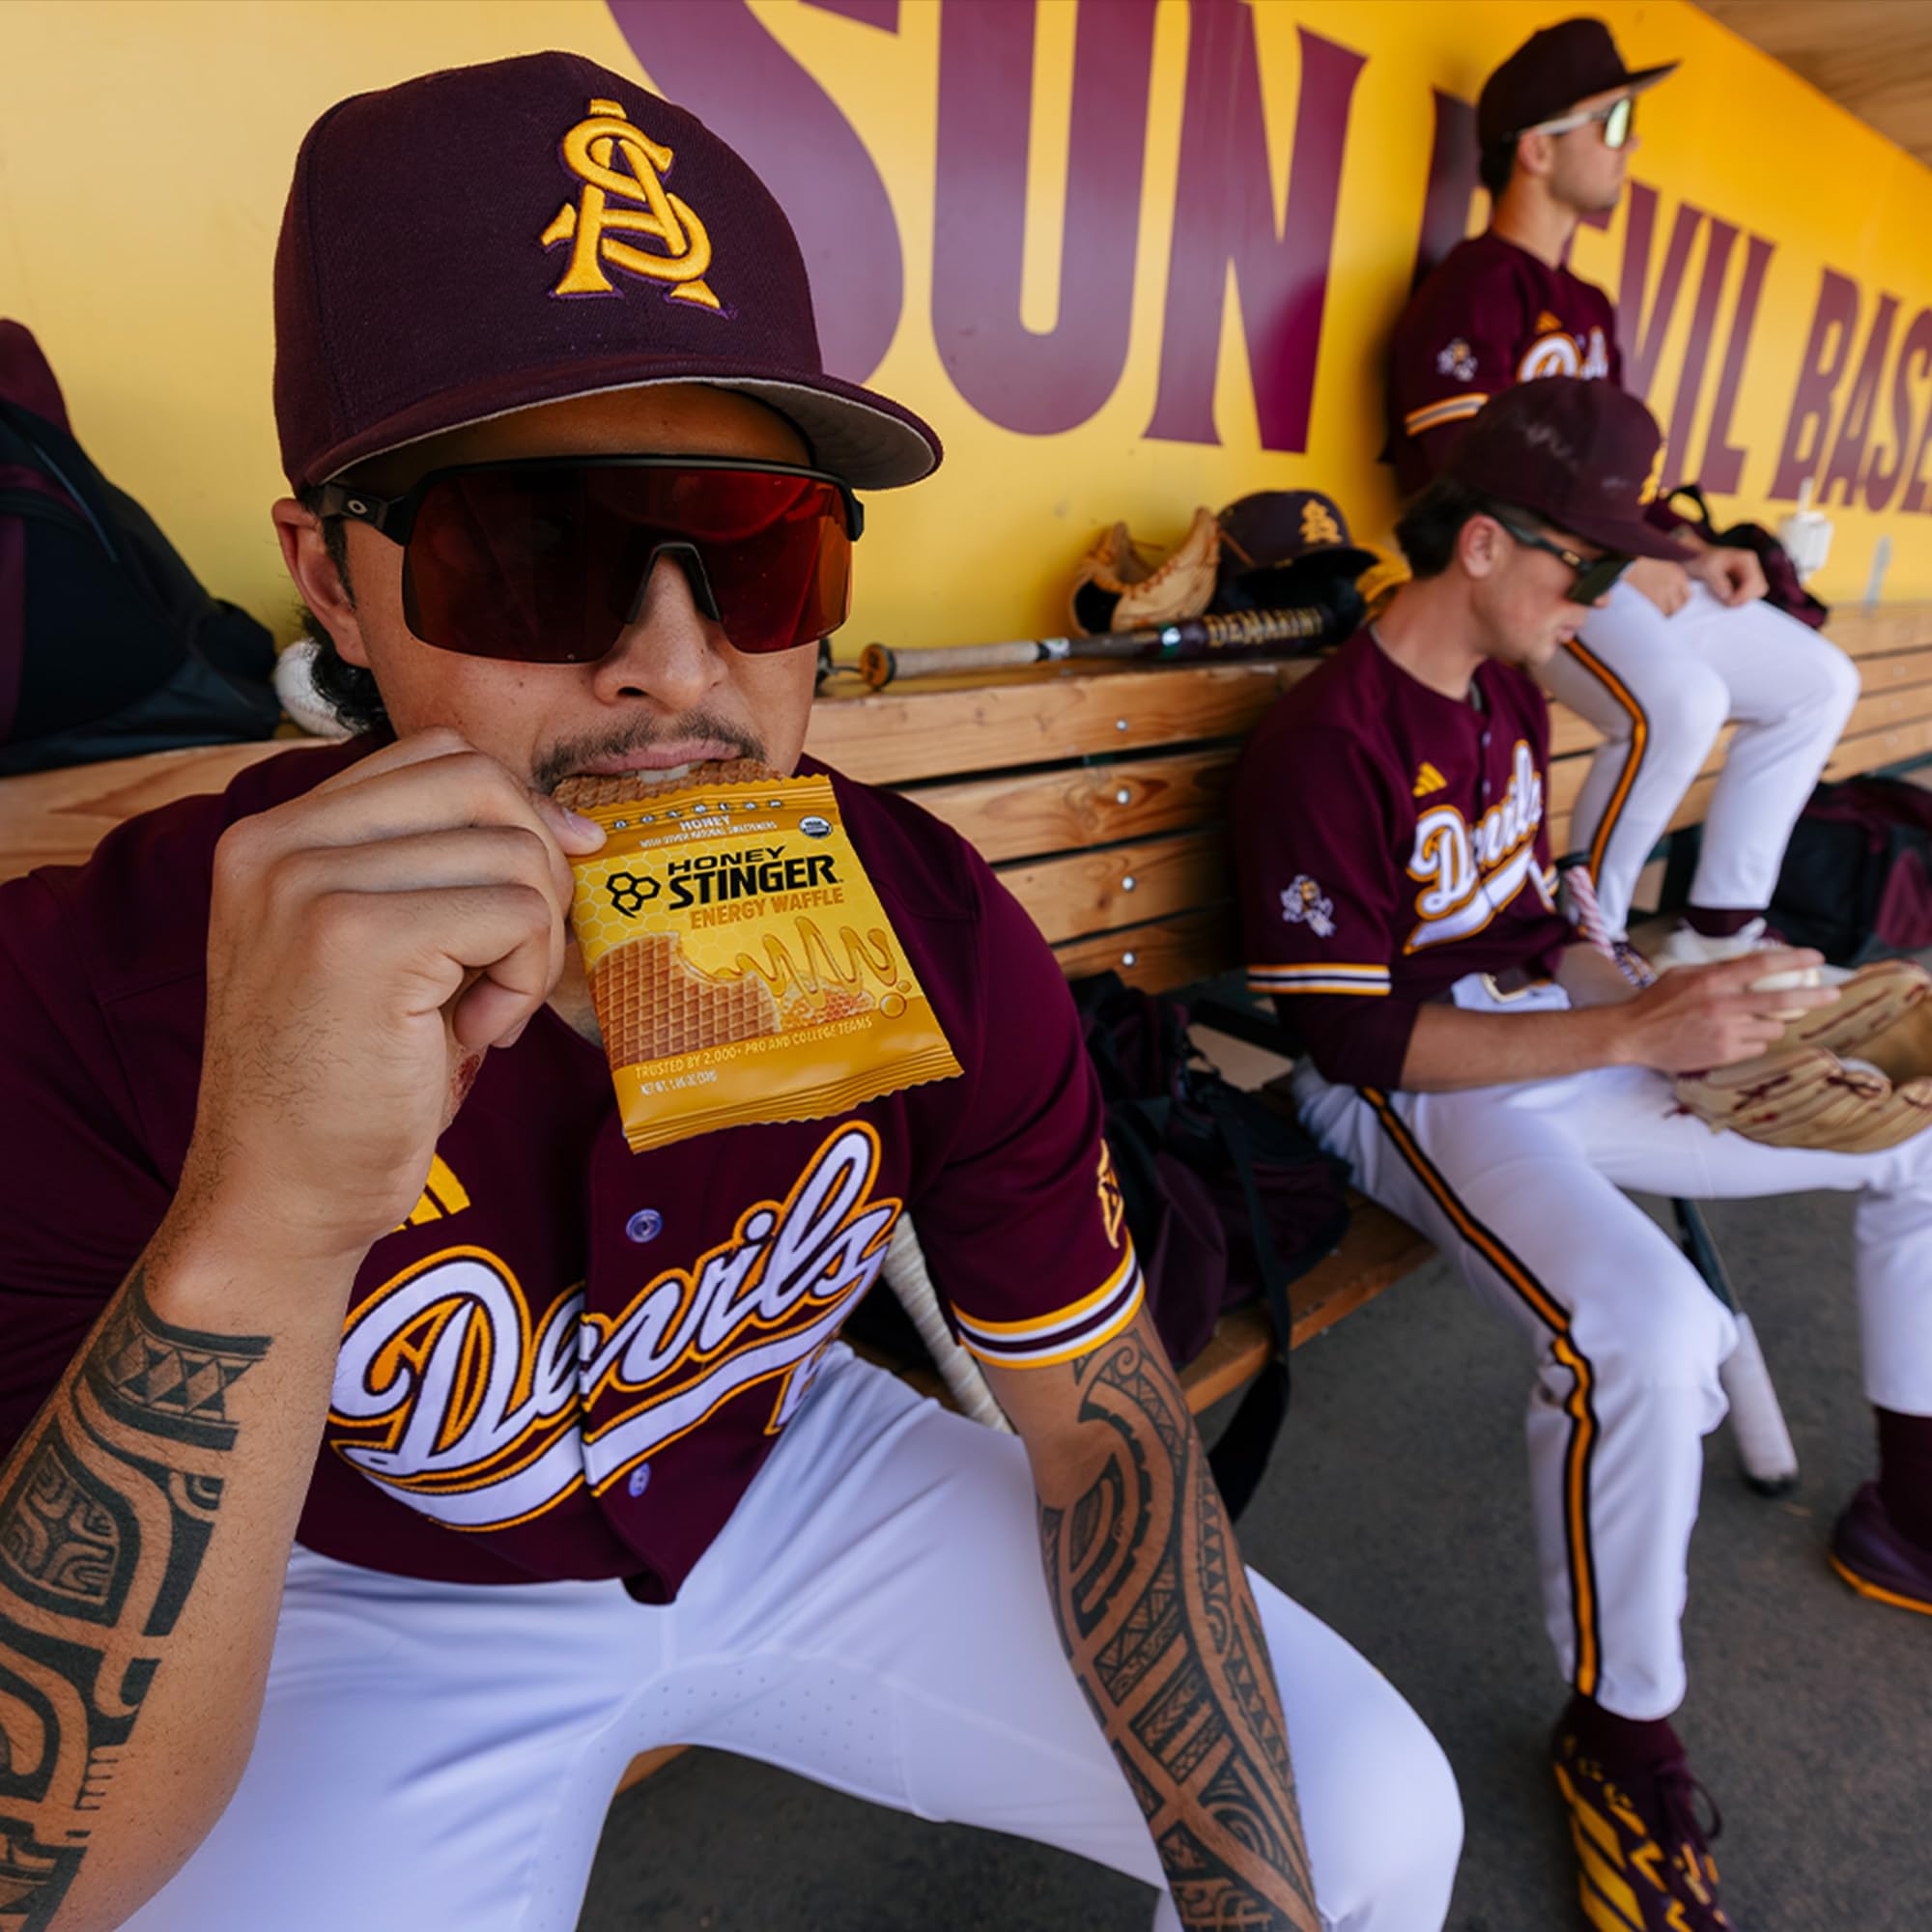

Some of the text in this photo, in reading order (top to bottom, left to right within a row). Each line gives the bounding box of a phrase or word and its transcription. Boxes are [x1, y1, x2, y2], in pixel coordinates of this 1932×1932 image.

[680, 815, 730, 832] HONEY
[668, 845, 785, 876] HONEY
[668, 854, 838, 911] STINGER
[690, 888, 844, 930] ENERGY WAFFLE
[636, 1059, 684, 1080] TRUSTED
[687, 1055, 701, 1069] BY
[744, 1037, 767, 1055] PRO
[768, 1033, 791, 1051] AND
[792, 1024, 836, 1046] COLLEGE
[838, 1015, 873, 1036] TEAMS
